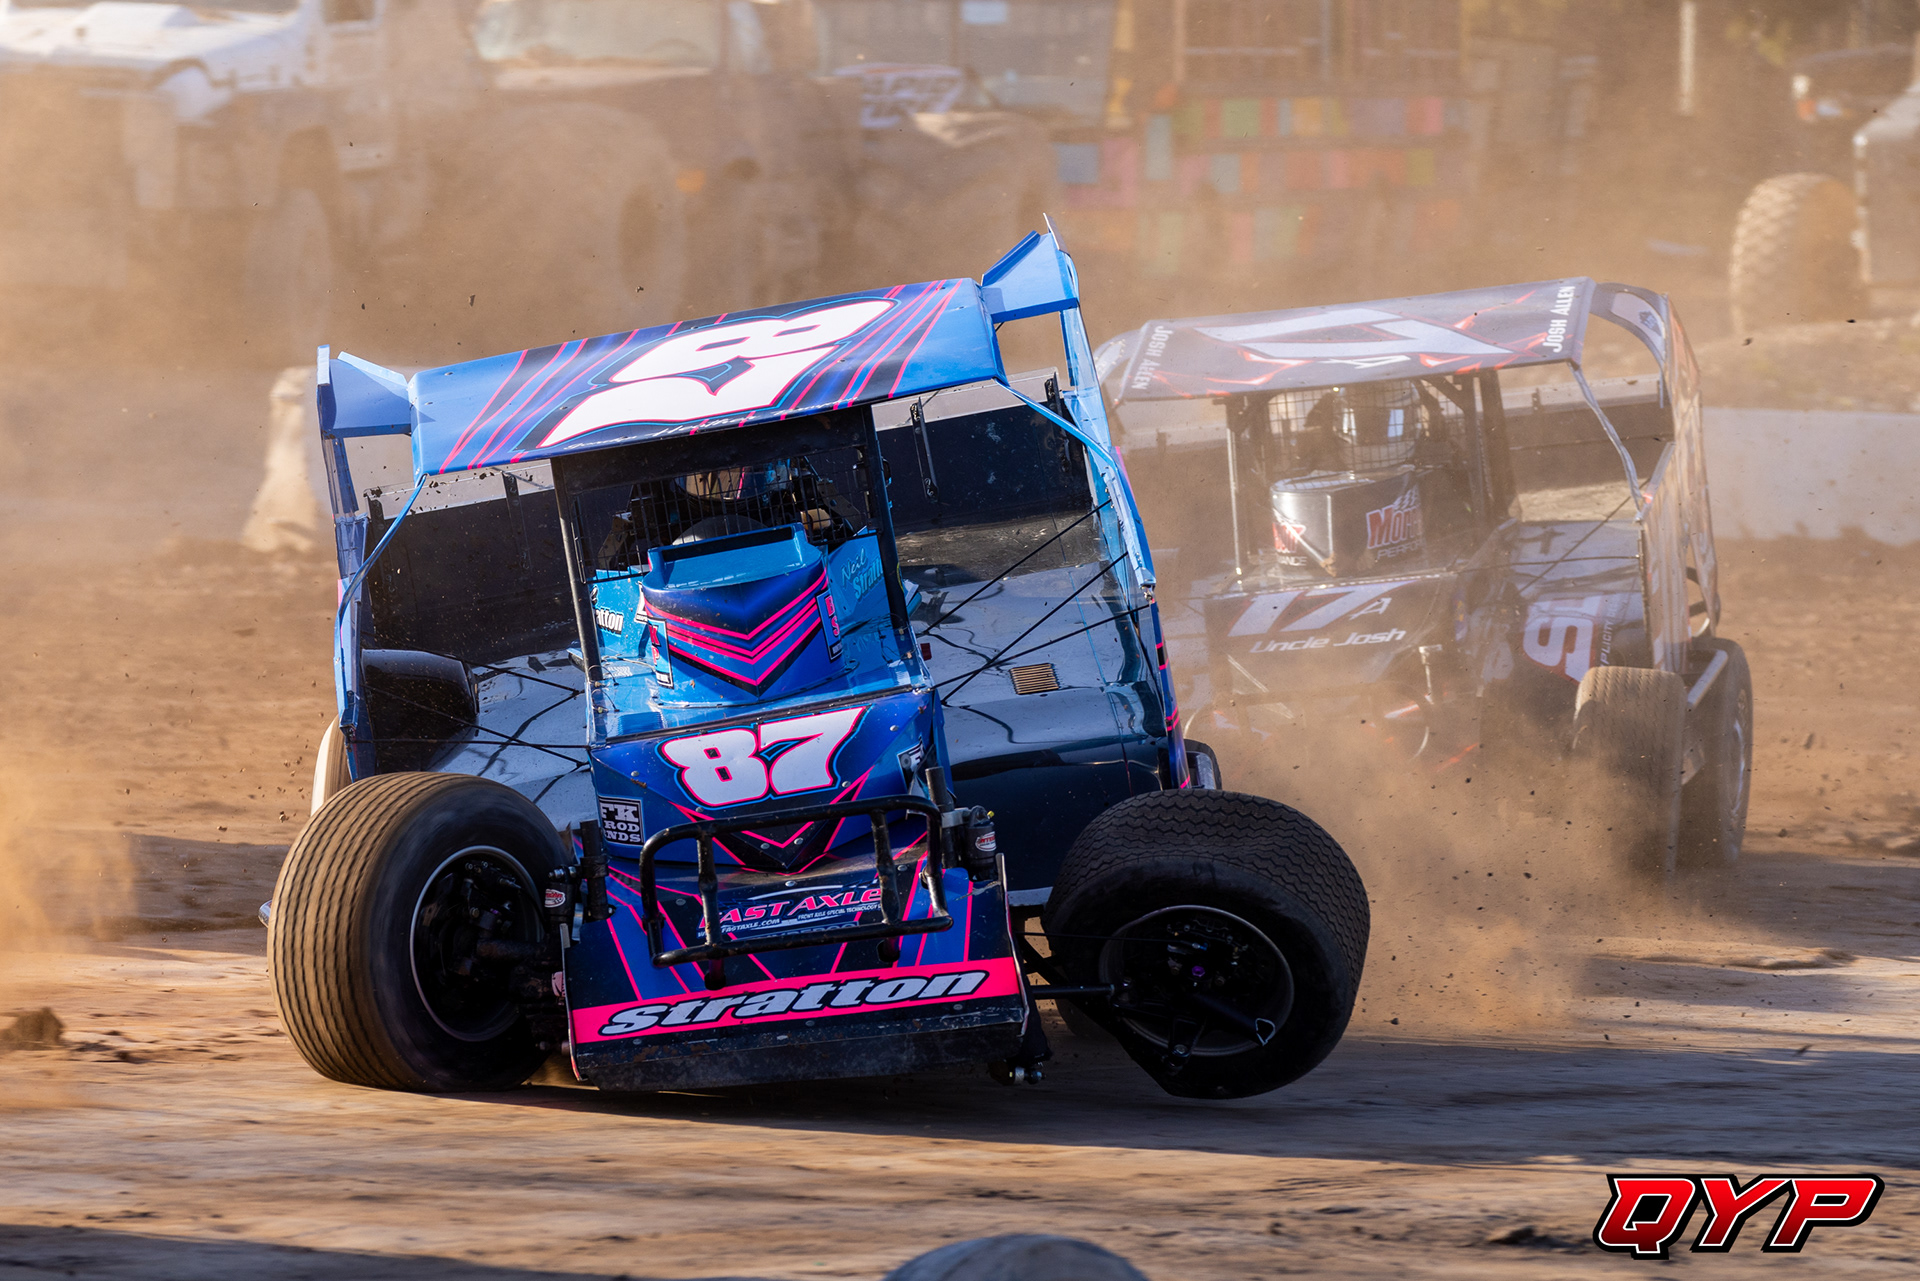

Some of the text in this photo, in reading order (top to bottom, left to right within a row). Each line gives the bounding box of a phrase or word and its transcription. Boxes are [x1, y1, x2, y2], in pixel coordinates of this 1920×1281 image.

[1543, 285, 1577, 354] JOSH ALLEN
[1145, 325, 1175, 358] JOSH
[535, 299, 896, 450] 87
[841, 547, 868, 590] Neil
[1226, 579, 1421, 638] 17
[1249, 627, 1407, 653] Uncle Josh
[660, 704, 868, 807] 87
[603, 820, 641, 833] ROD
[605, 829, 642, 843] NDS
